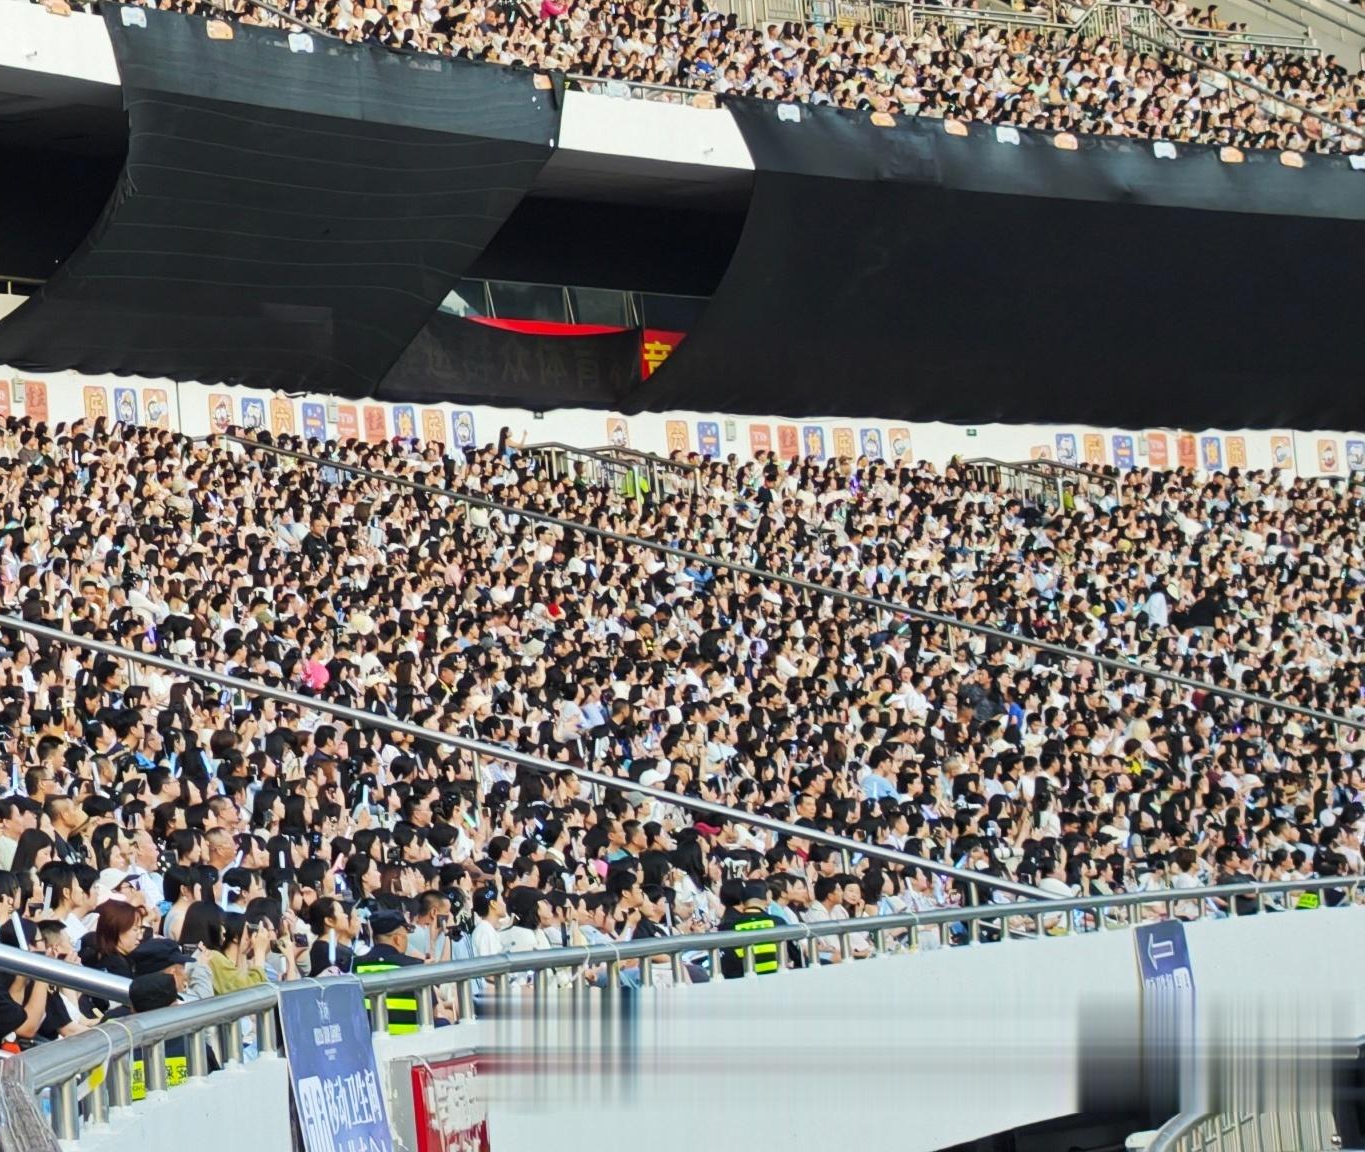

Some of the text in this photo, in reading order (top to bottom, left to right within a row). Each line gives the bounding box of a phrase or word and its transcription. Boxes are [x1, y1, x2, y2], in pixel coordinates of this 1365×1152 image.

[323, 1068, 383, 1136] 移动卫生间
